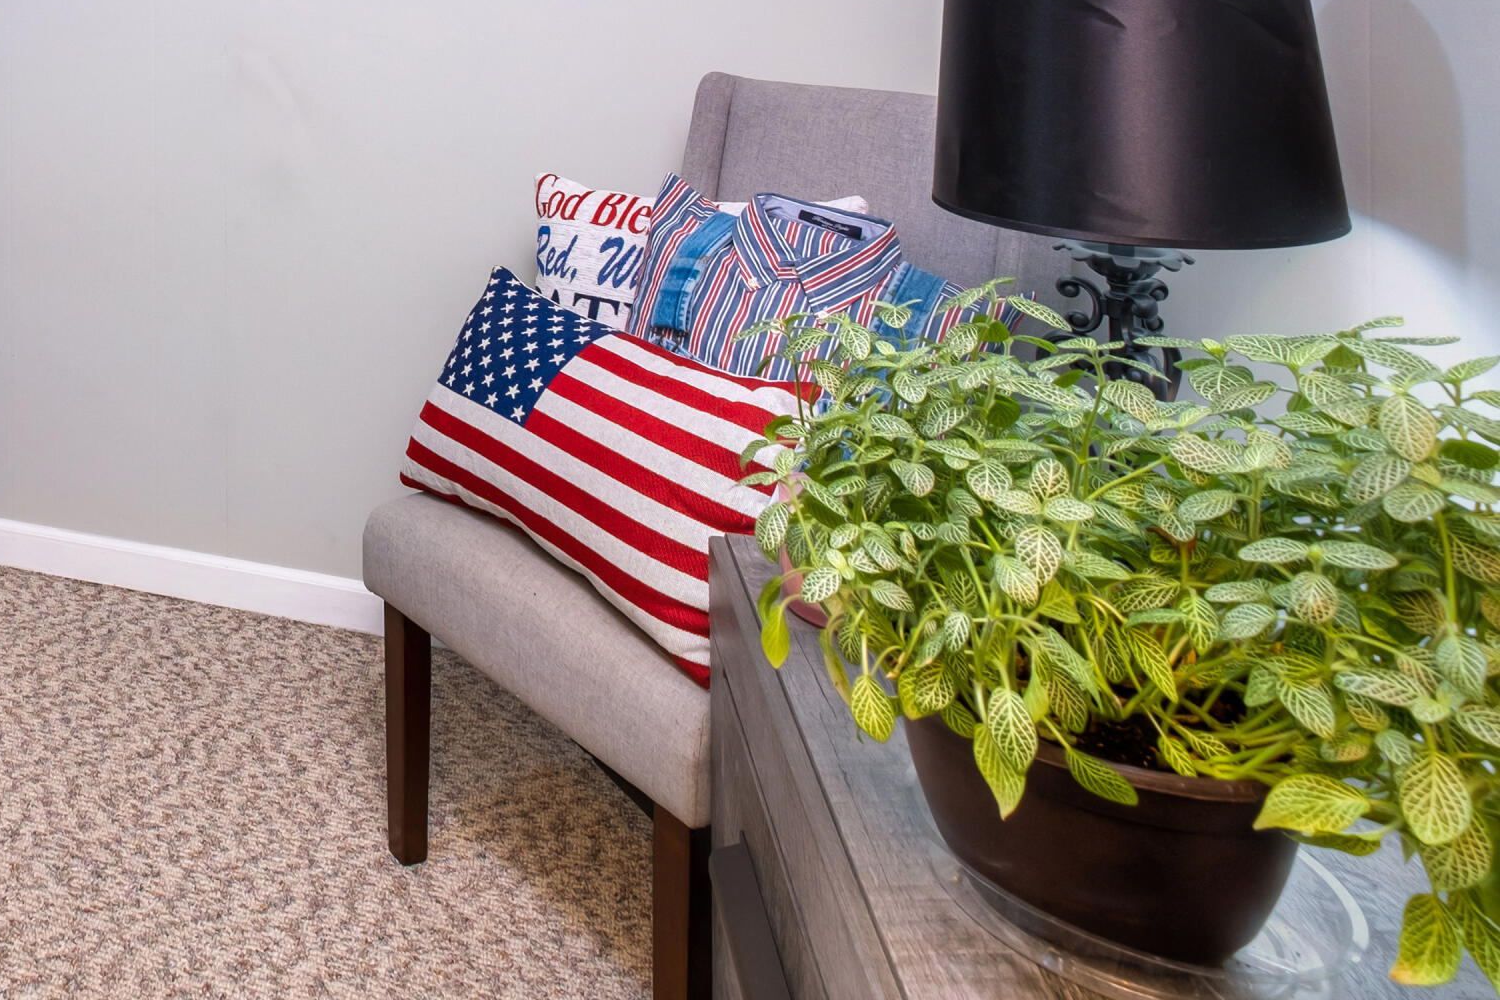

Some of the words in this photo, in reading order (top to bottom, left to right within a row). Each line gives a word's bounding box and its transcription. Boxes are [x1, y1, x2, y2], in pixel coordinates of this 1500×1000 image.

[536, 173, 596, 221] God
[589, 193, 653, 236] Ble
[537, 225, 579, 284] Red,
